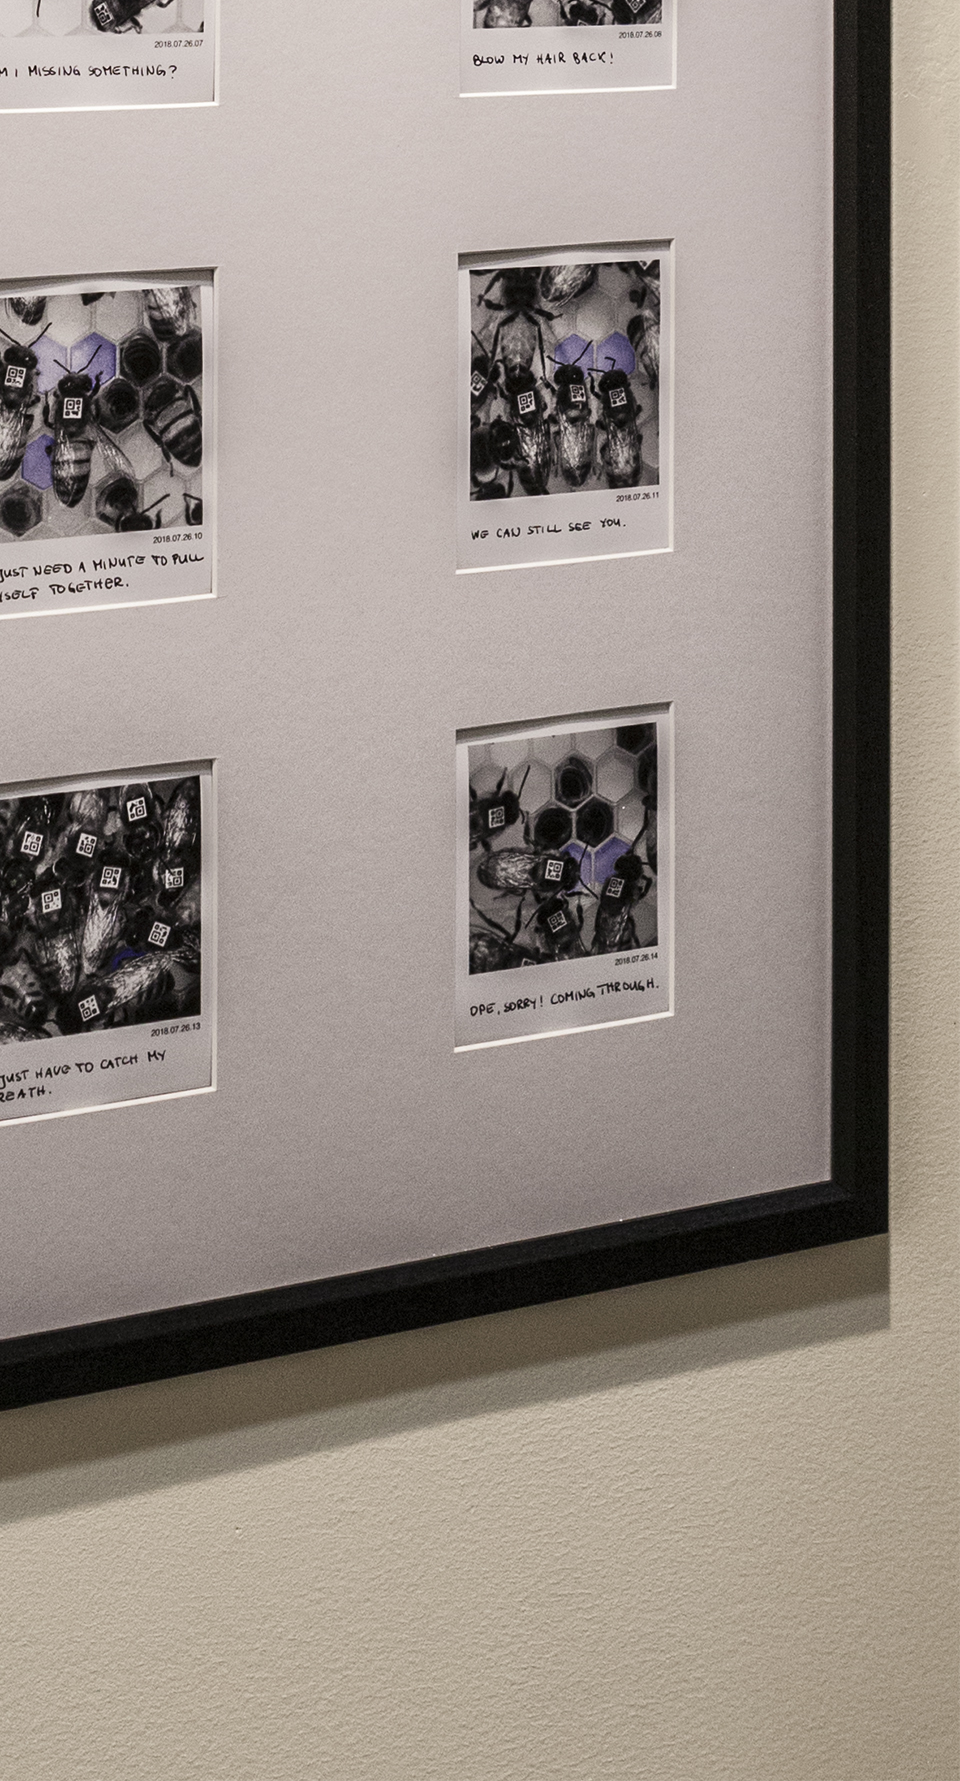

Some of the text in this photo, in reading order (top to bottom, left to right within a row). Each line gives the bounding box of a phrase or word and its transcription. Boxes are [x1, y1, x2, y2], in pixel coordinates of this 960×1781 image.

[619, 31, 662, 39] 2018.07.26.08
[154, 39, 203, 48] 2018.07.26.07
[473, 51, 613, 66] BLOW MY HAIR BACK!
[28, 65, 81, 77] MISSING
[88, 64, 177, 79] SOMETHING?
[616, 492, 659, 502] 2018.07.26.11
[496, 527, 520, 538] CAN
[527, 524, 562, 535] STILL
[600, 518, 626, 528] YOU.
[153, 532, 203, 544] 2018.07.26.10
[33, 564, 72, 576] NEED
[92, 555, 146, 571] MINUTE
[151, 555, 167, 566] TO
[172, 553, 204, 565] PULL
[49, 577, 129, 595] TOGETHER.
[615, 952, 658, 966] 2018.07.26.14
[504, 995, 543, 1013] SORRY!
[550, 988, 595, 1004] COMING
[597, 977, 659, 995] THROUGH.
[151, 1021, 201, 1037] 2018.07.26.13
[75, 1062, 94, 1073] TO
[100, 1054, 138, 1069] CATCH
[147, 1050, 166, 1062] MY
